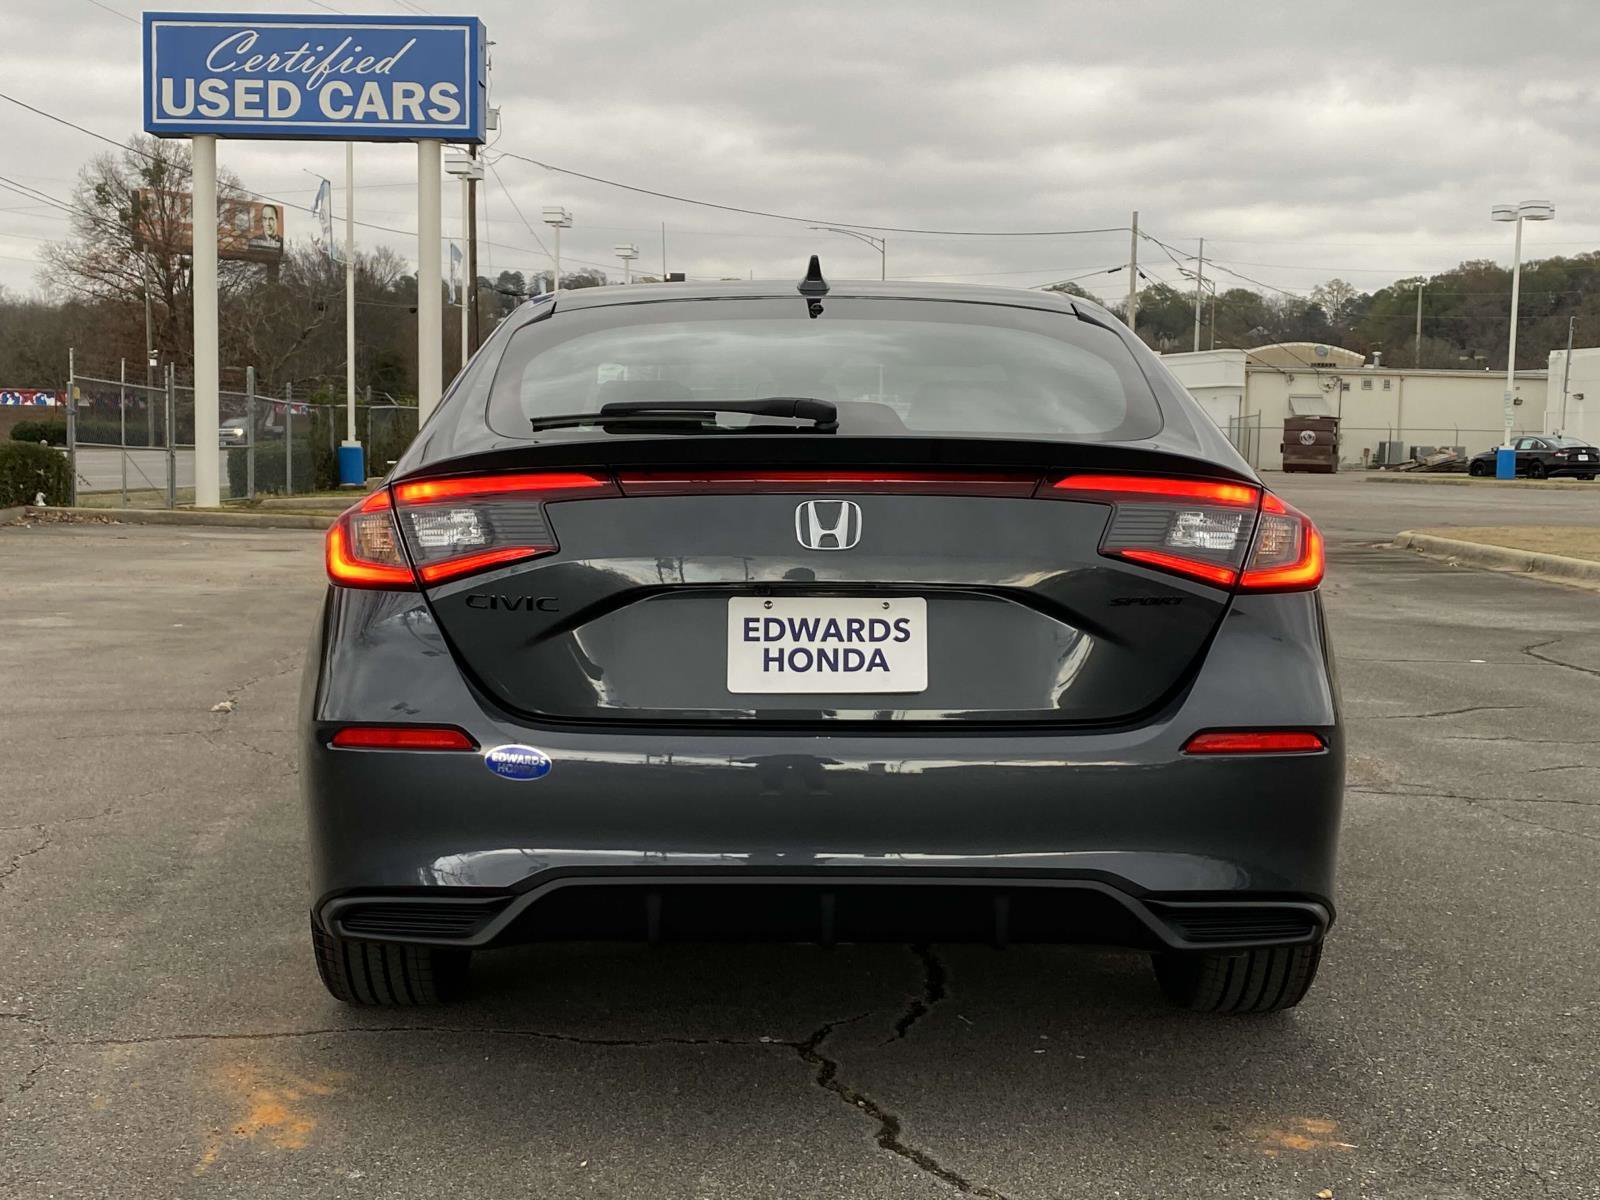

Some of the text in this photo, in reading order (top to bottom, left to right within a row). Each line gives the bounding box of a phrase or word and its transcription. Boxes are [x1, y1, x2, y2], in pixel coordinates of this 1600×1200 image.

[206, 29, 417, 91] Certified
[161, 77, 461, 122] USED CARS
[465, 594, 560, 612] CIVIC
[1109, 596, 1183, 607] SPORT
[743, 617, 911, 643] EDWARDS
[763, 647, 891, 672] HONDA
[491, 752, 546, 767] EDWARDS
